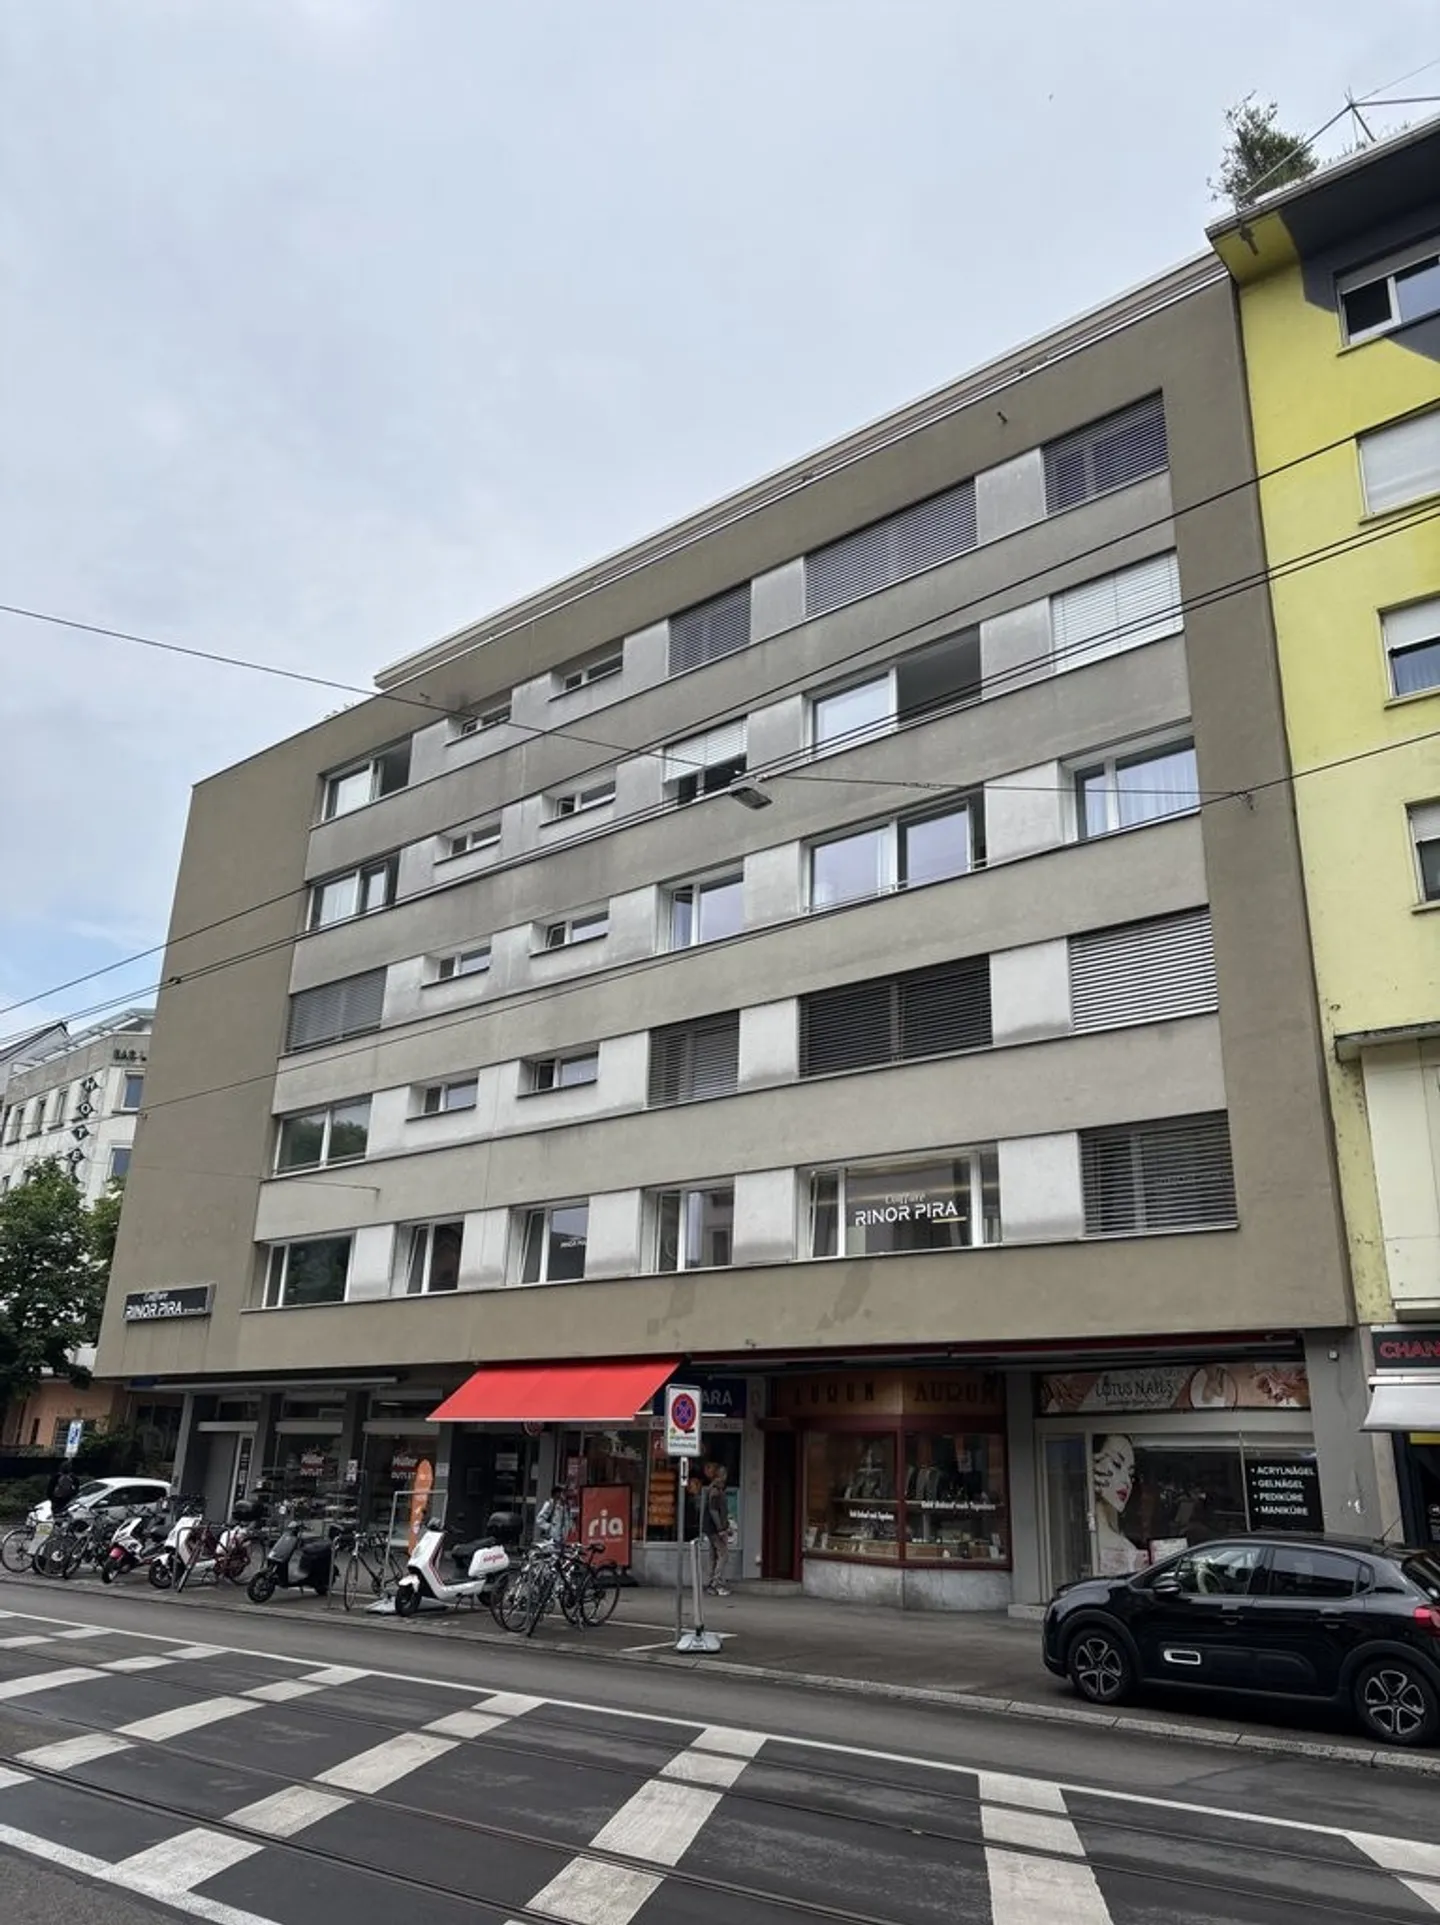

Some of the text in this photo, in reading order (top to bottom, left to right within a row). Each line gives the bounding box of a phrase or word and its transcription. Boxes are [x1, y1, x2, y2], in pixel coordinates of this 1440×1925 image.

[855, 1200, 959, 1227] RINOR PIRA
[125, 1303, 158, 1319] RINOR
[158, 1301, 182, 1317] PIRA
[913, 1380, 996, 1404] AURUM
[1096, 1377, 1174, 1401] LOTUS NAILS
[1256, 1465, 1316, 1476] ACRYLNÄGEL
[1257, 1478, 1304, 1489] GELNÄGEL
[1259, 1491, 1304, 1503] PEDIKÜRE
[1260, 1505, 1309, 1517] MANIKÜRE
[588, 1508, 624, 1538] ria
